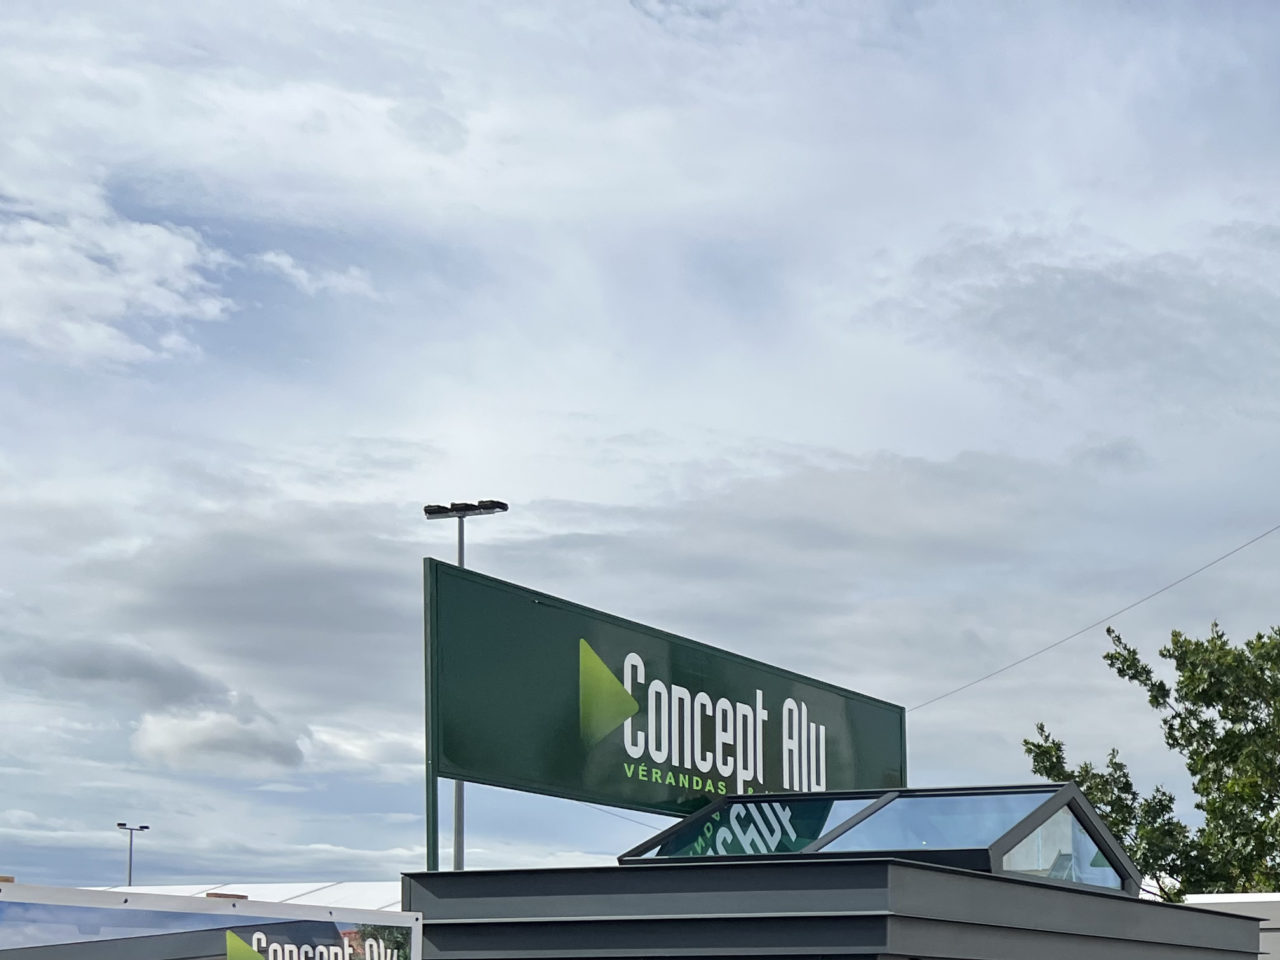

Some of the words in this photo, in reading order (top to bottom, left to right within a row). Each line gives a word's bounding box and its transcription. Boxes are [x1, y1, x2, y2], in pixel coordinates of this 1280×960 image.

[623, 652, 768, 795] Concept
[783, 697, 827, 792] Alu
[624, 762, 728, 796] VÉRANDAS
